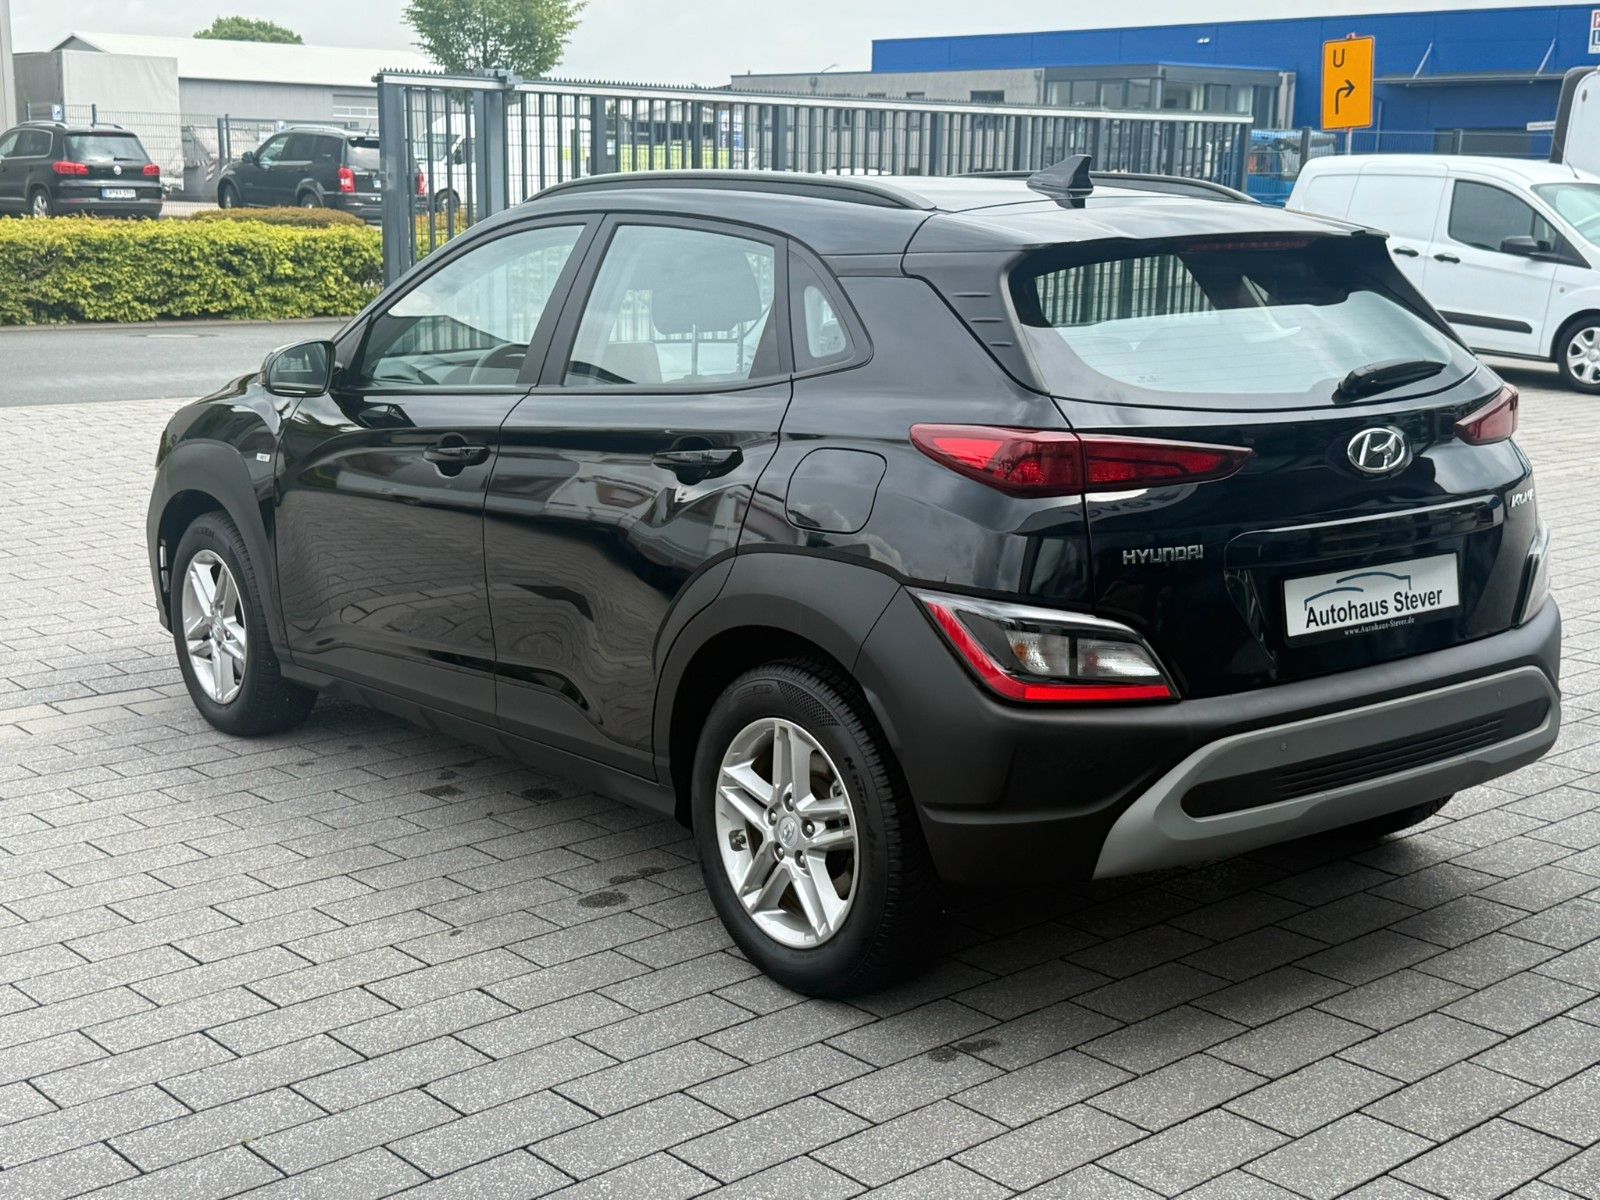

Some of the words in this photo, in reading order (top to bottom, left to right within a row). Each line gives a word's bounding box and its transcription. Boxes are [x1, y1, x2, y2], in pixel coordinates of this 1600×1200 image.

[1333, 48, 1345, 68] U
[1122, 544, 1204, 565] HYUNDAI
[1306, 599, 1389, 628] Autohaus
[1394, 589, 1443, 613] Stever
[1344, 617, 1415, 636] www.Autohaus-Stever.de
